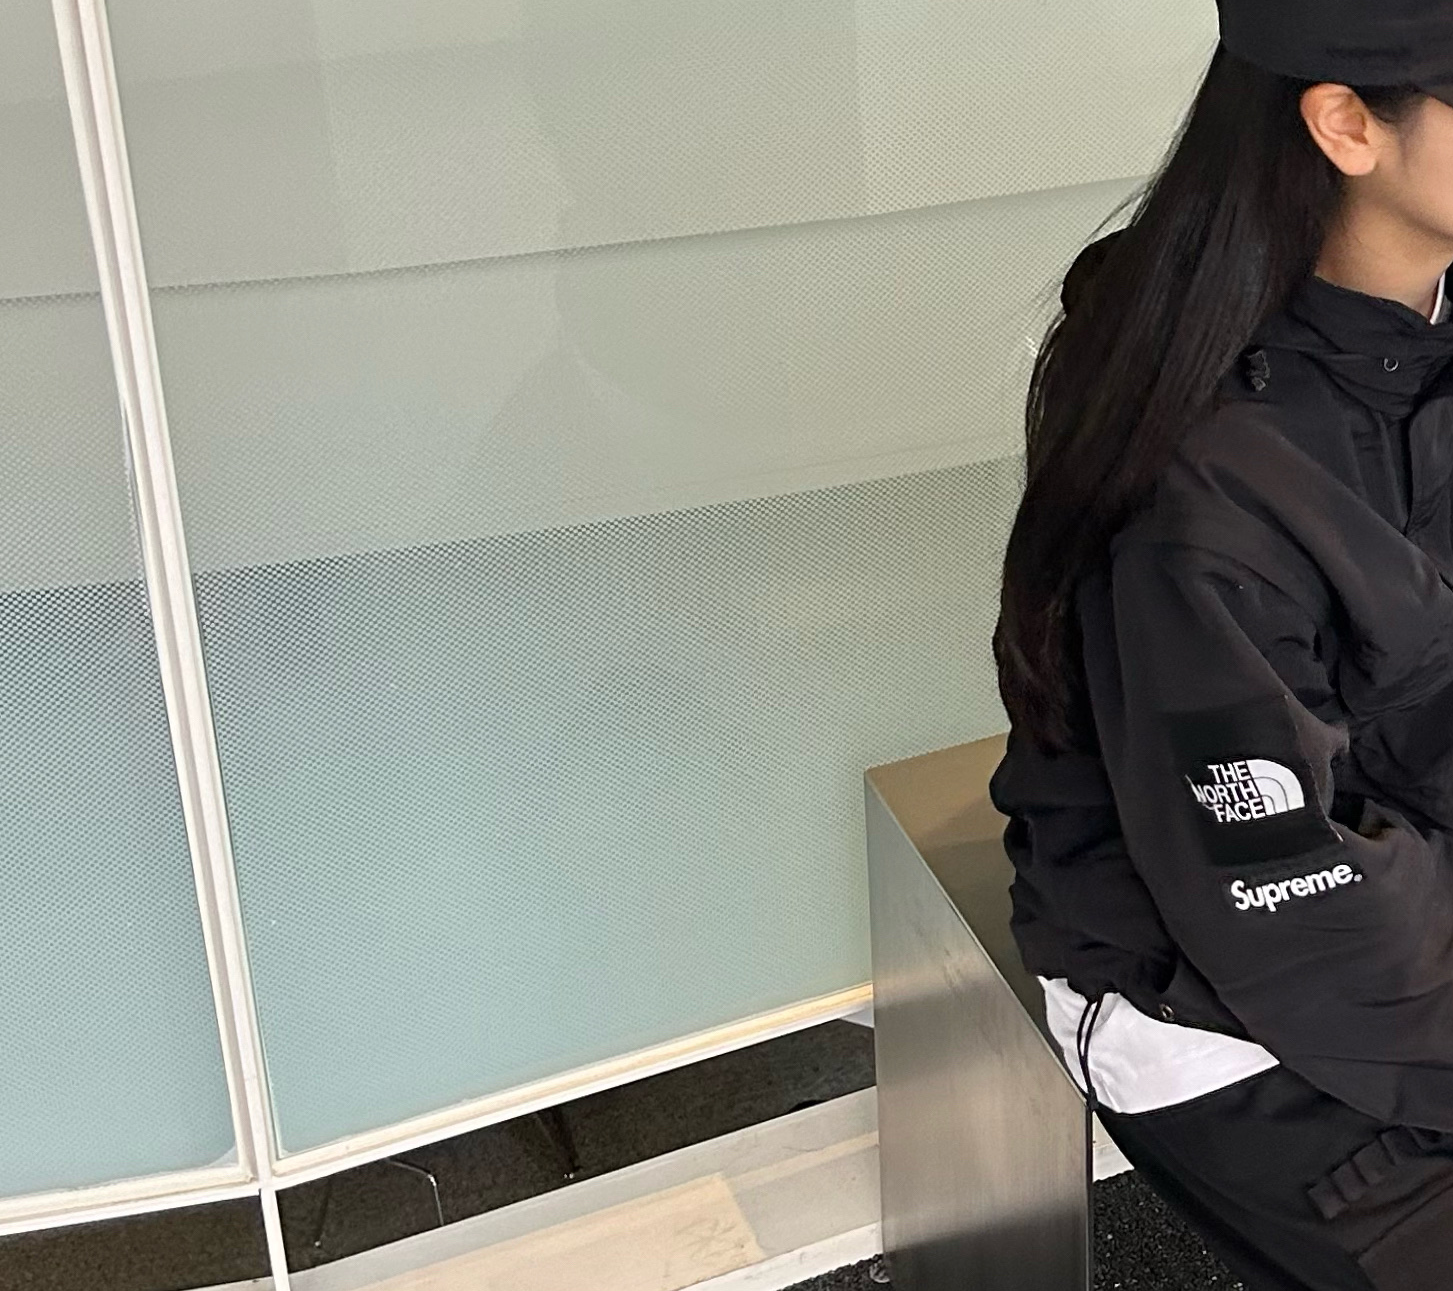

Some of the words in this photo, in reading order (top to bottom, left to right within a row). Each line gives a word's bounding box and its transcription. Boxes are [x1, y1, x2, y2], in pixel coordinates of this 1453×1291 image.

[1207, 761, 1251, 783] THE
[1190, 779, 1259, 804] NORTH
[1214, 798, 1267, 823] FACE
